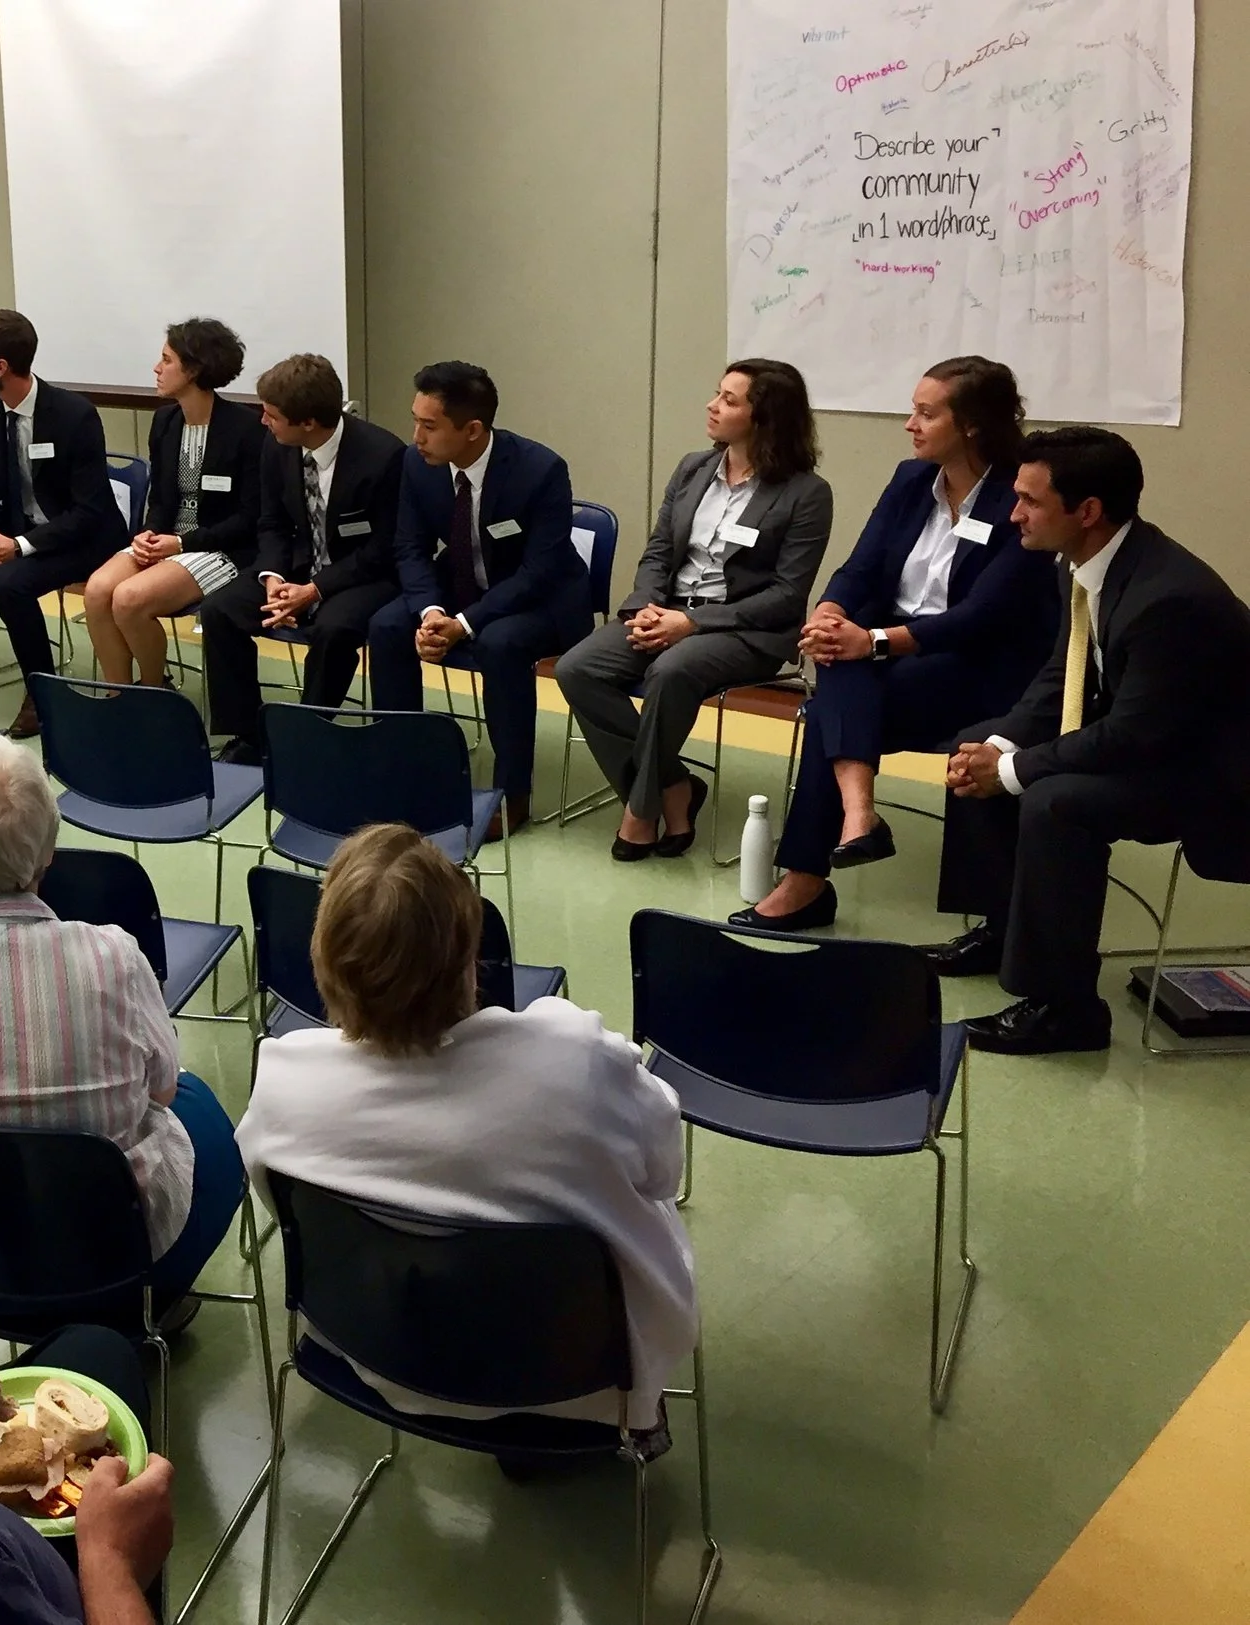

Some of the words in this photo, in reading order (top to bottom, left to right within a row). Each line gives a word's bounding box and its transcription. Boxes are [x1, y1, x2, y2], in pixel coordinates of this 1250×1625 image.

[802, 26, 850, 43] vibrant
[836, 60, 908, 93] Optimistic
[855, 132, 935, 160] Describe
[945, 136, 989, 161] your
[862, 167, 980, 208] community
[858, 222, 874, 239] in
[879, 211, 890, 239] 1
